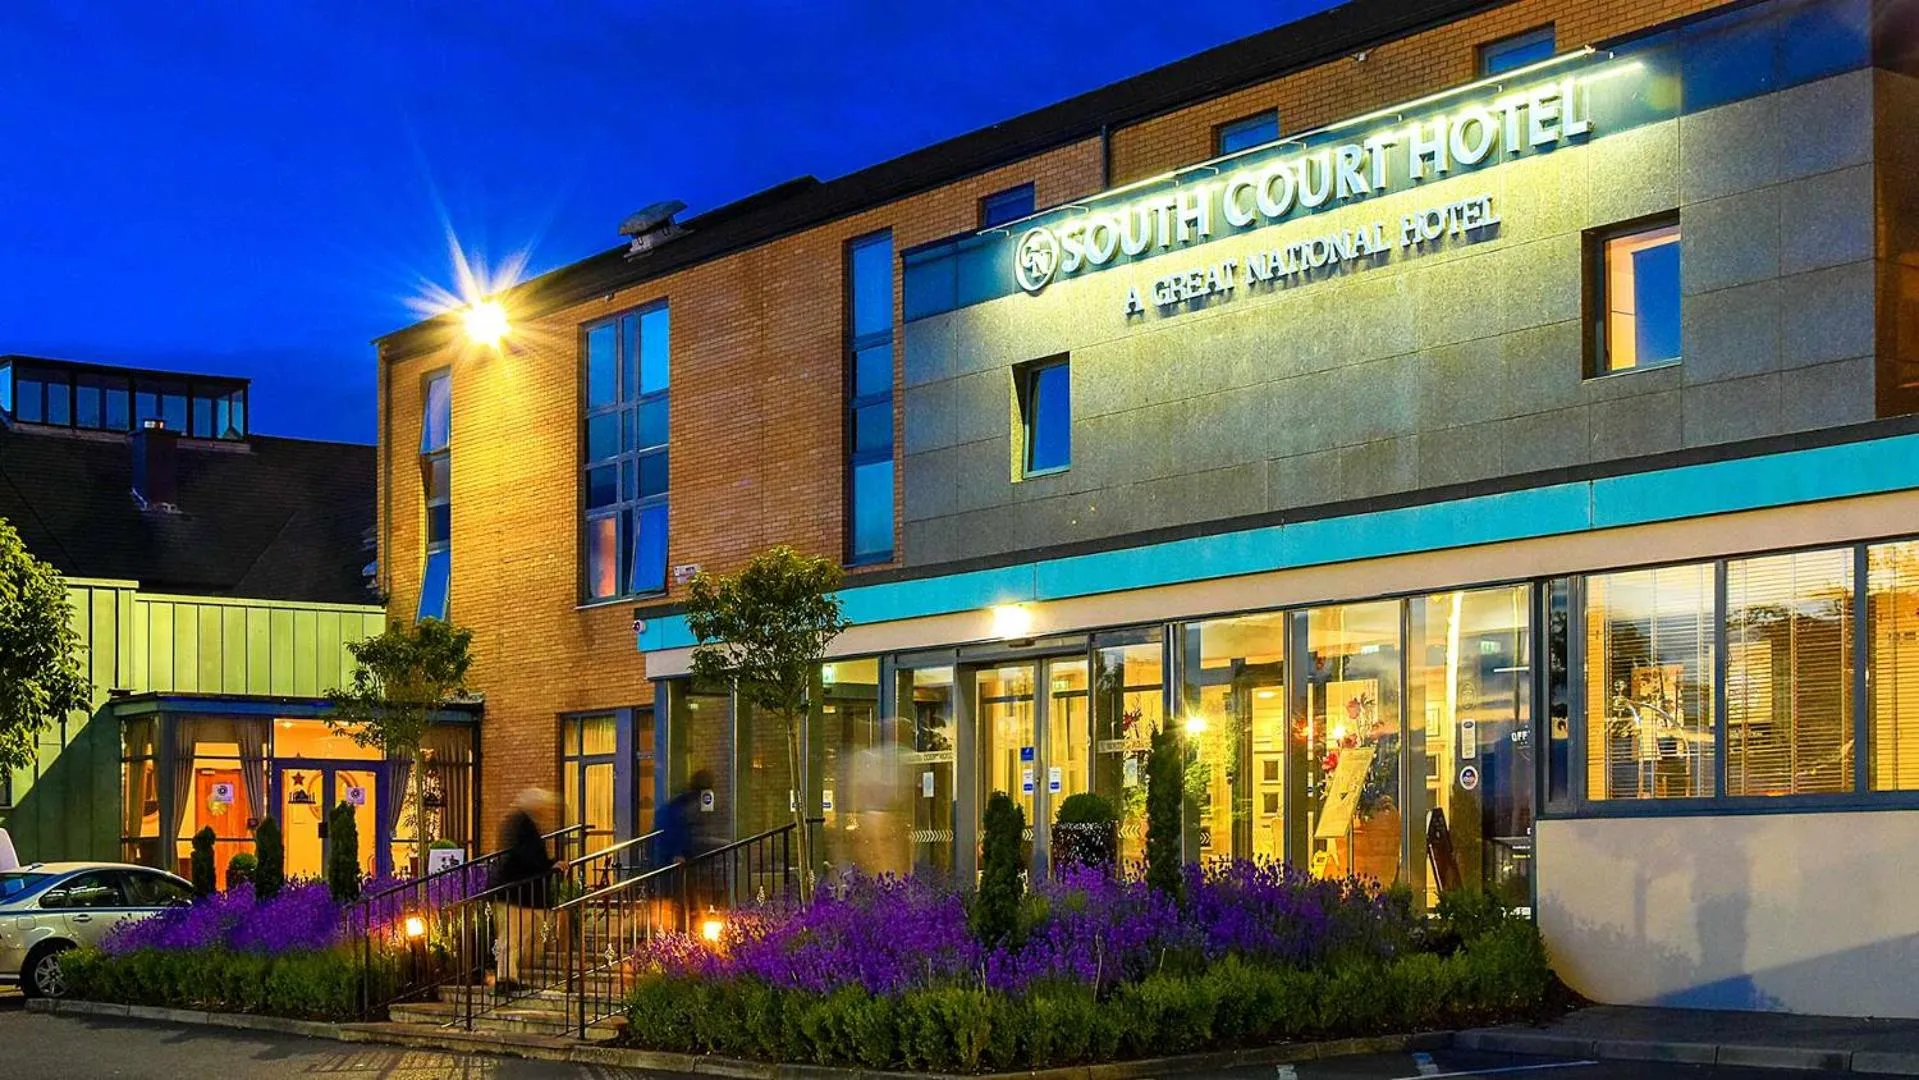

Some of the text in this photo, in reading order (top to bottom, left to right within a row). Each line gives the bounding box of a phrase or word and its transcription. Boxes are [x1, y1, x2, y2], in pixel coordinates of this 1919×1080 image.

[1058, 76, 1594, 274] SOUTH COURT HOTEL
[1124, 193, 1501, 315] A GREAT NATIONAL HOTEL
